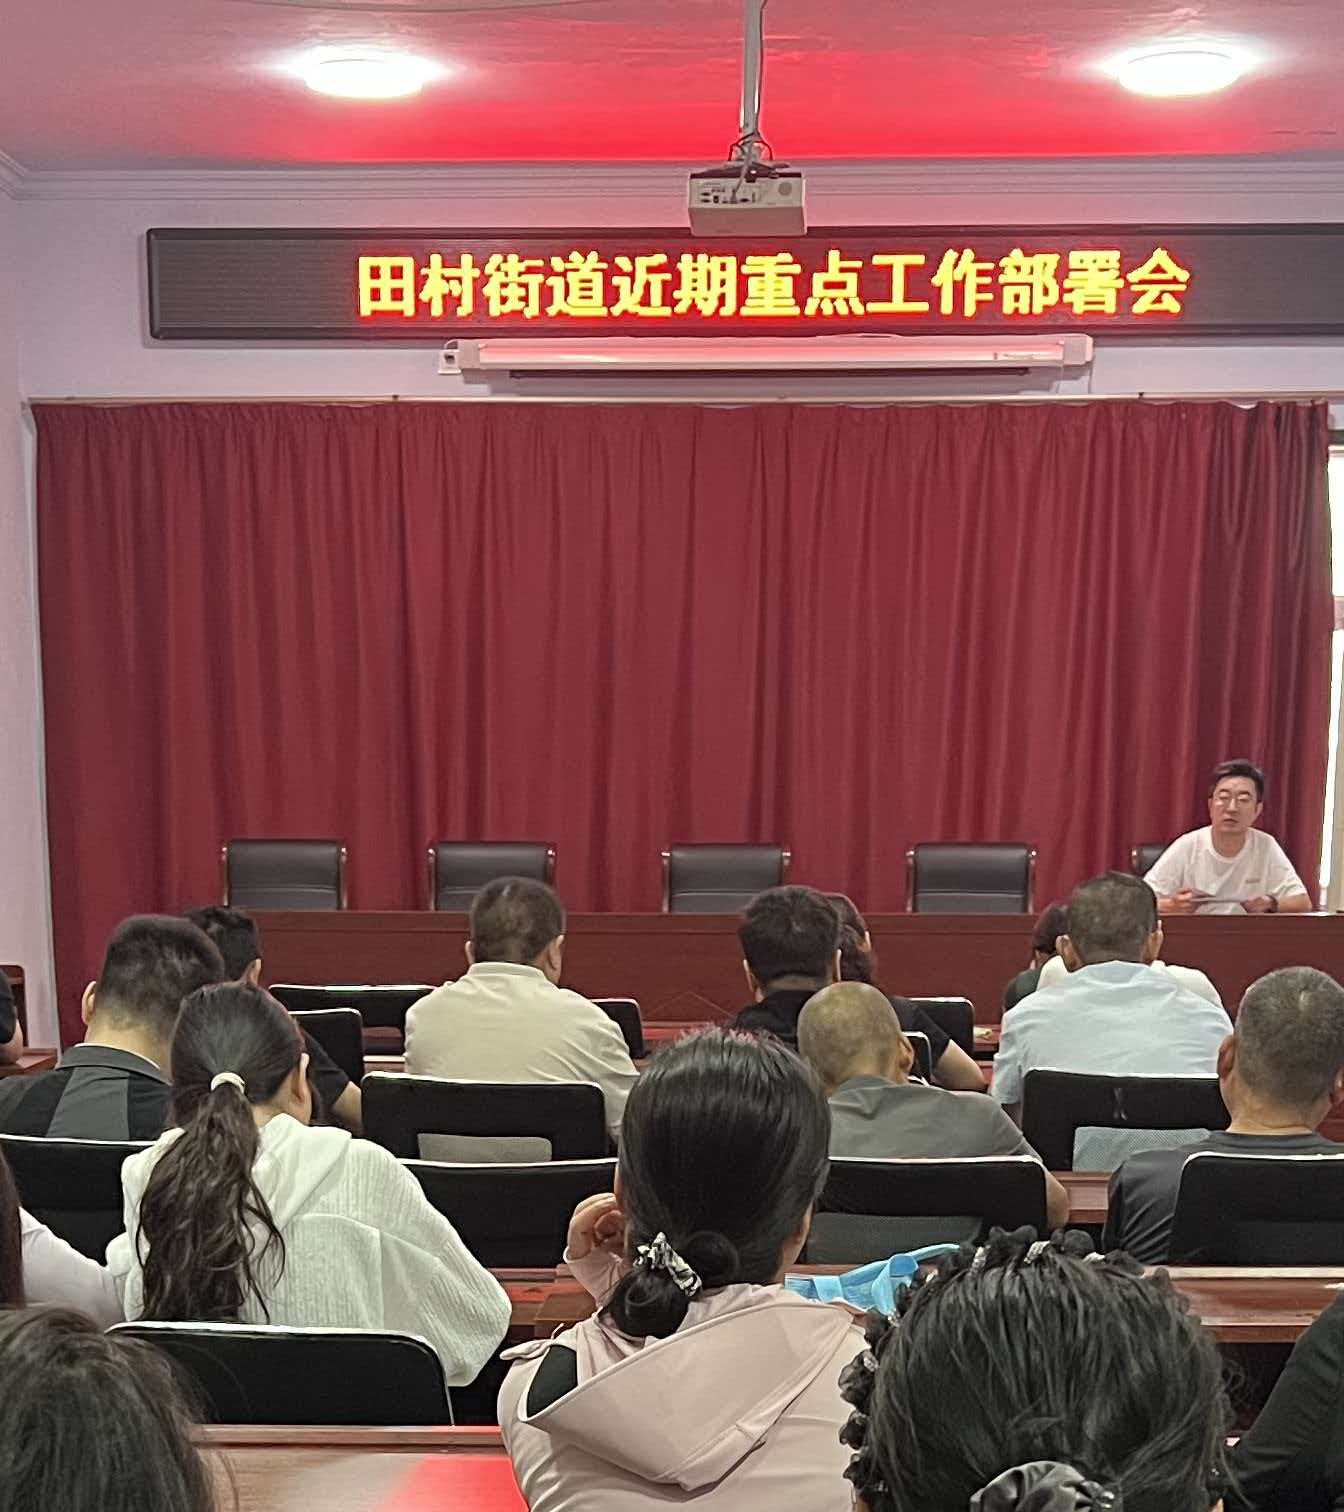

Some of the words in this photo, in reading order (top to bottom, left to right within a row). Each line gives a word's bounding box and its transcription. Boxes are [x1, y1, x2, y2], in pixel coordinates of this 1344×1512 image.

[358, 248, 1190, 319] 田村街道近期重点工作部署会
